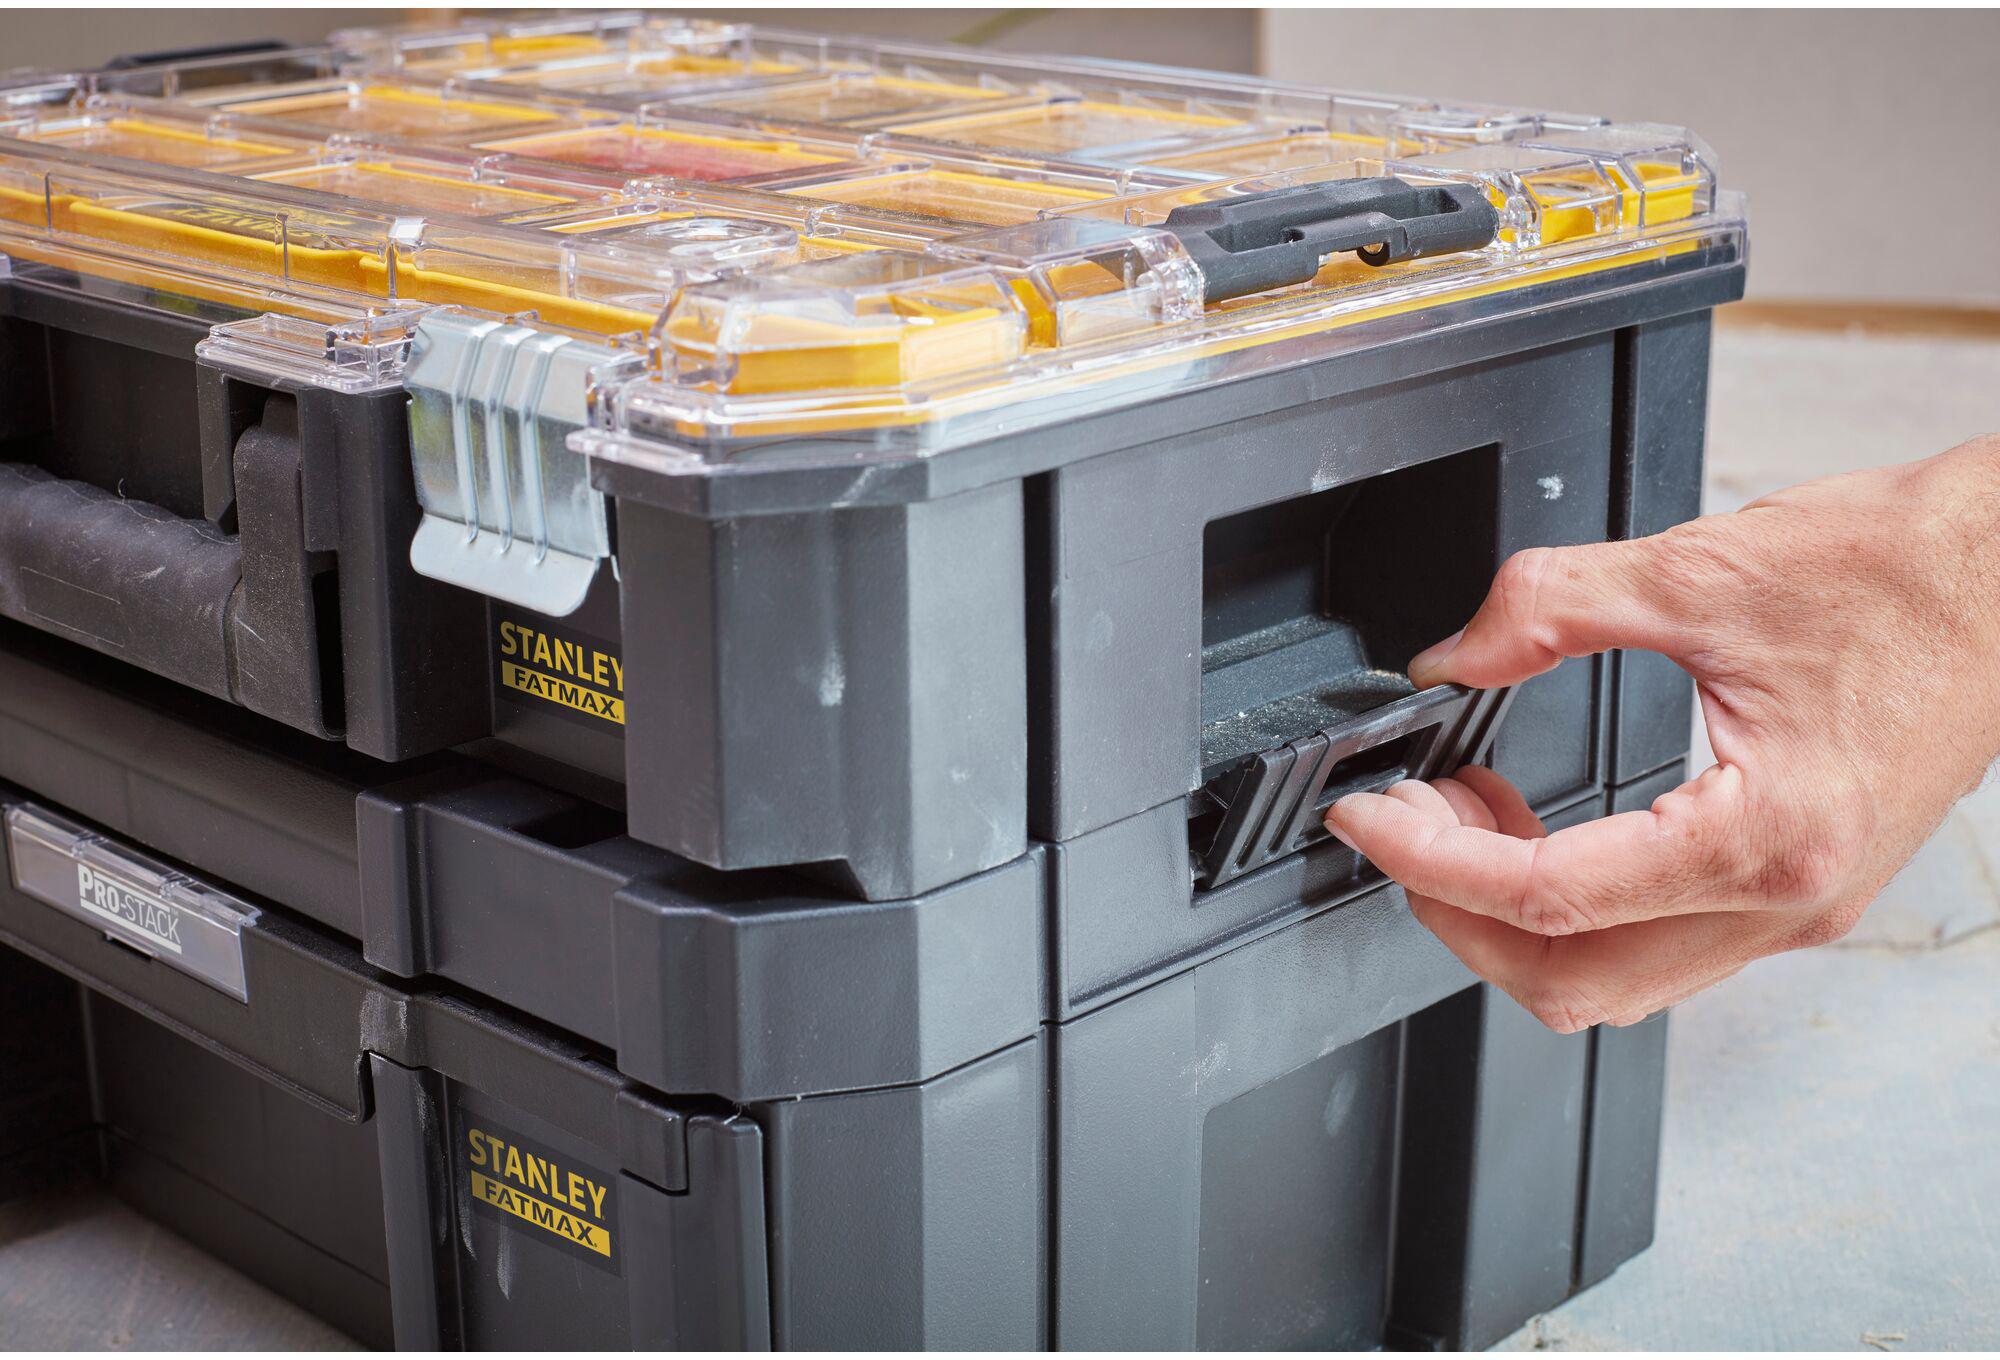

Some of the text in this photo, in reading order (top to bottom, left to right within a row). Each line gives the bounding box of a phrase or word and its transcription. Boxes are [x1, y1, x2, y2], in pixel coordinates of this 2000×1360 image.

[500, 621, 624, 692] STANLEY
[514, 668, 617, 719] FATMAX
[468, 1128, 607, 1220] STANLEY
[484, 1179, 595, 1247] FATMAX
